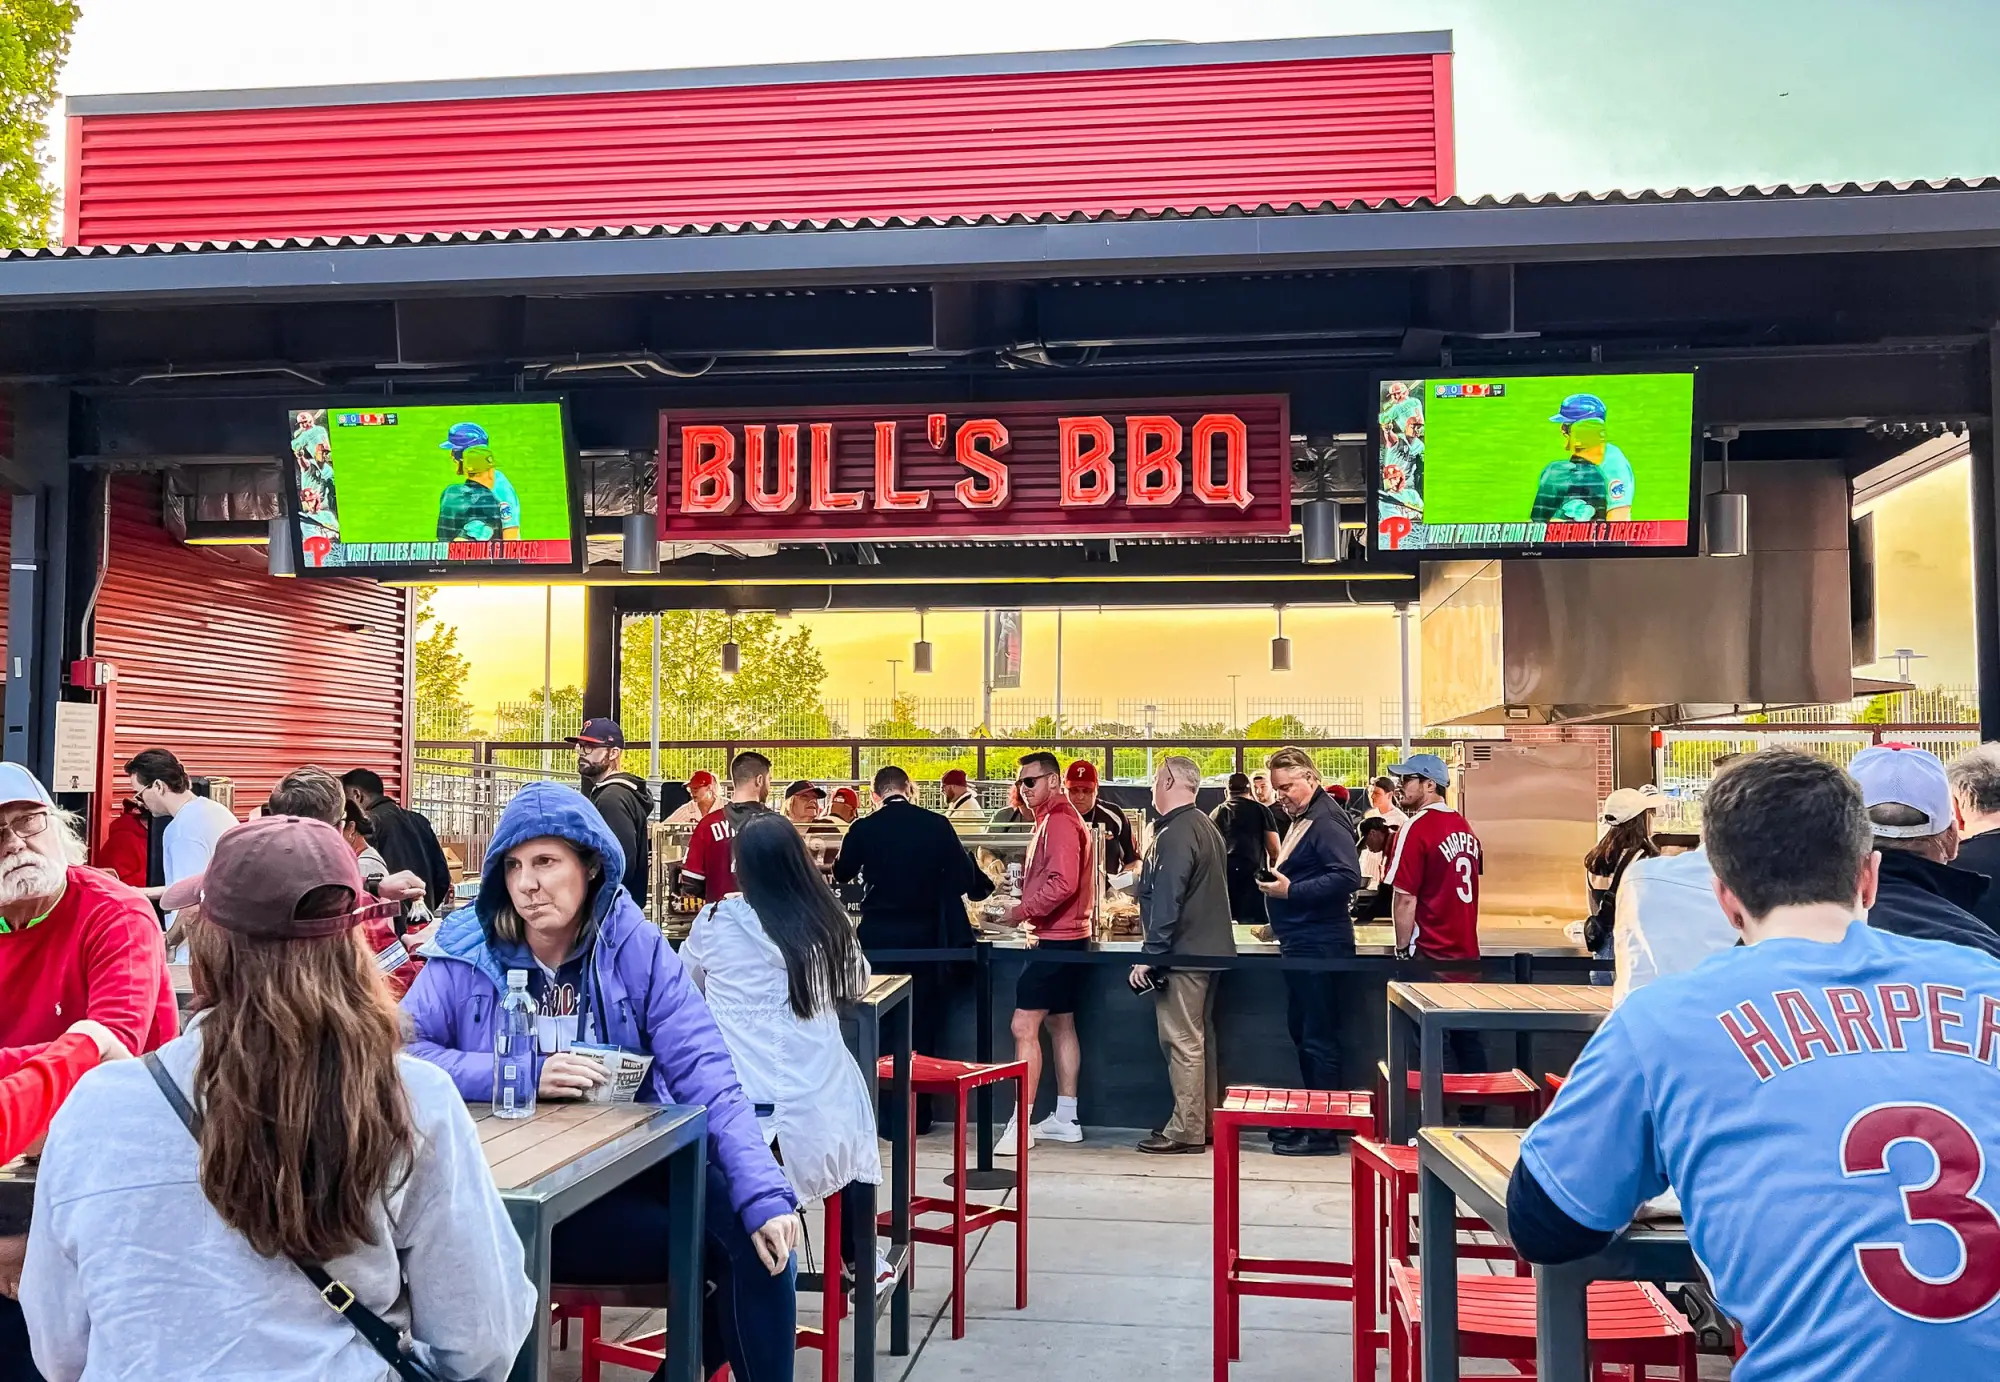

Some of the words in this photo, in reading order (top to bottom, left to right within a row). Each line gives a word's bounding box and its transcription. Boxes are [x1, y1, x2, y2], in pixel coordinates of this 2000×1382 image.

[680, 413, 1009, 513] BULL'S
[1058, 413, 1254, 513] BBQ
[346, 543, 371, 561] VISIT
[370, 542, 430, 561] PHILLIES.COM
[431, 541, 449, 560] FOR
[448, 541, 493, 560] SCHEDULE
[502, 541, 538, 559] TICKETS
[1428, 523, 1456, 543] VISIT
[1455, 522, 1527, 543] PHILLIES.COM
[1525, 522, 1547, 542] FOR
[1545, 521, 1597, 542] SCHEDULE
[1607, 521, 1650, 541] TICKETS
[1456, 857, 1472, 903] 3
[1839, 1100, 2000, 1324] 3
